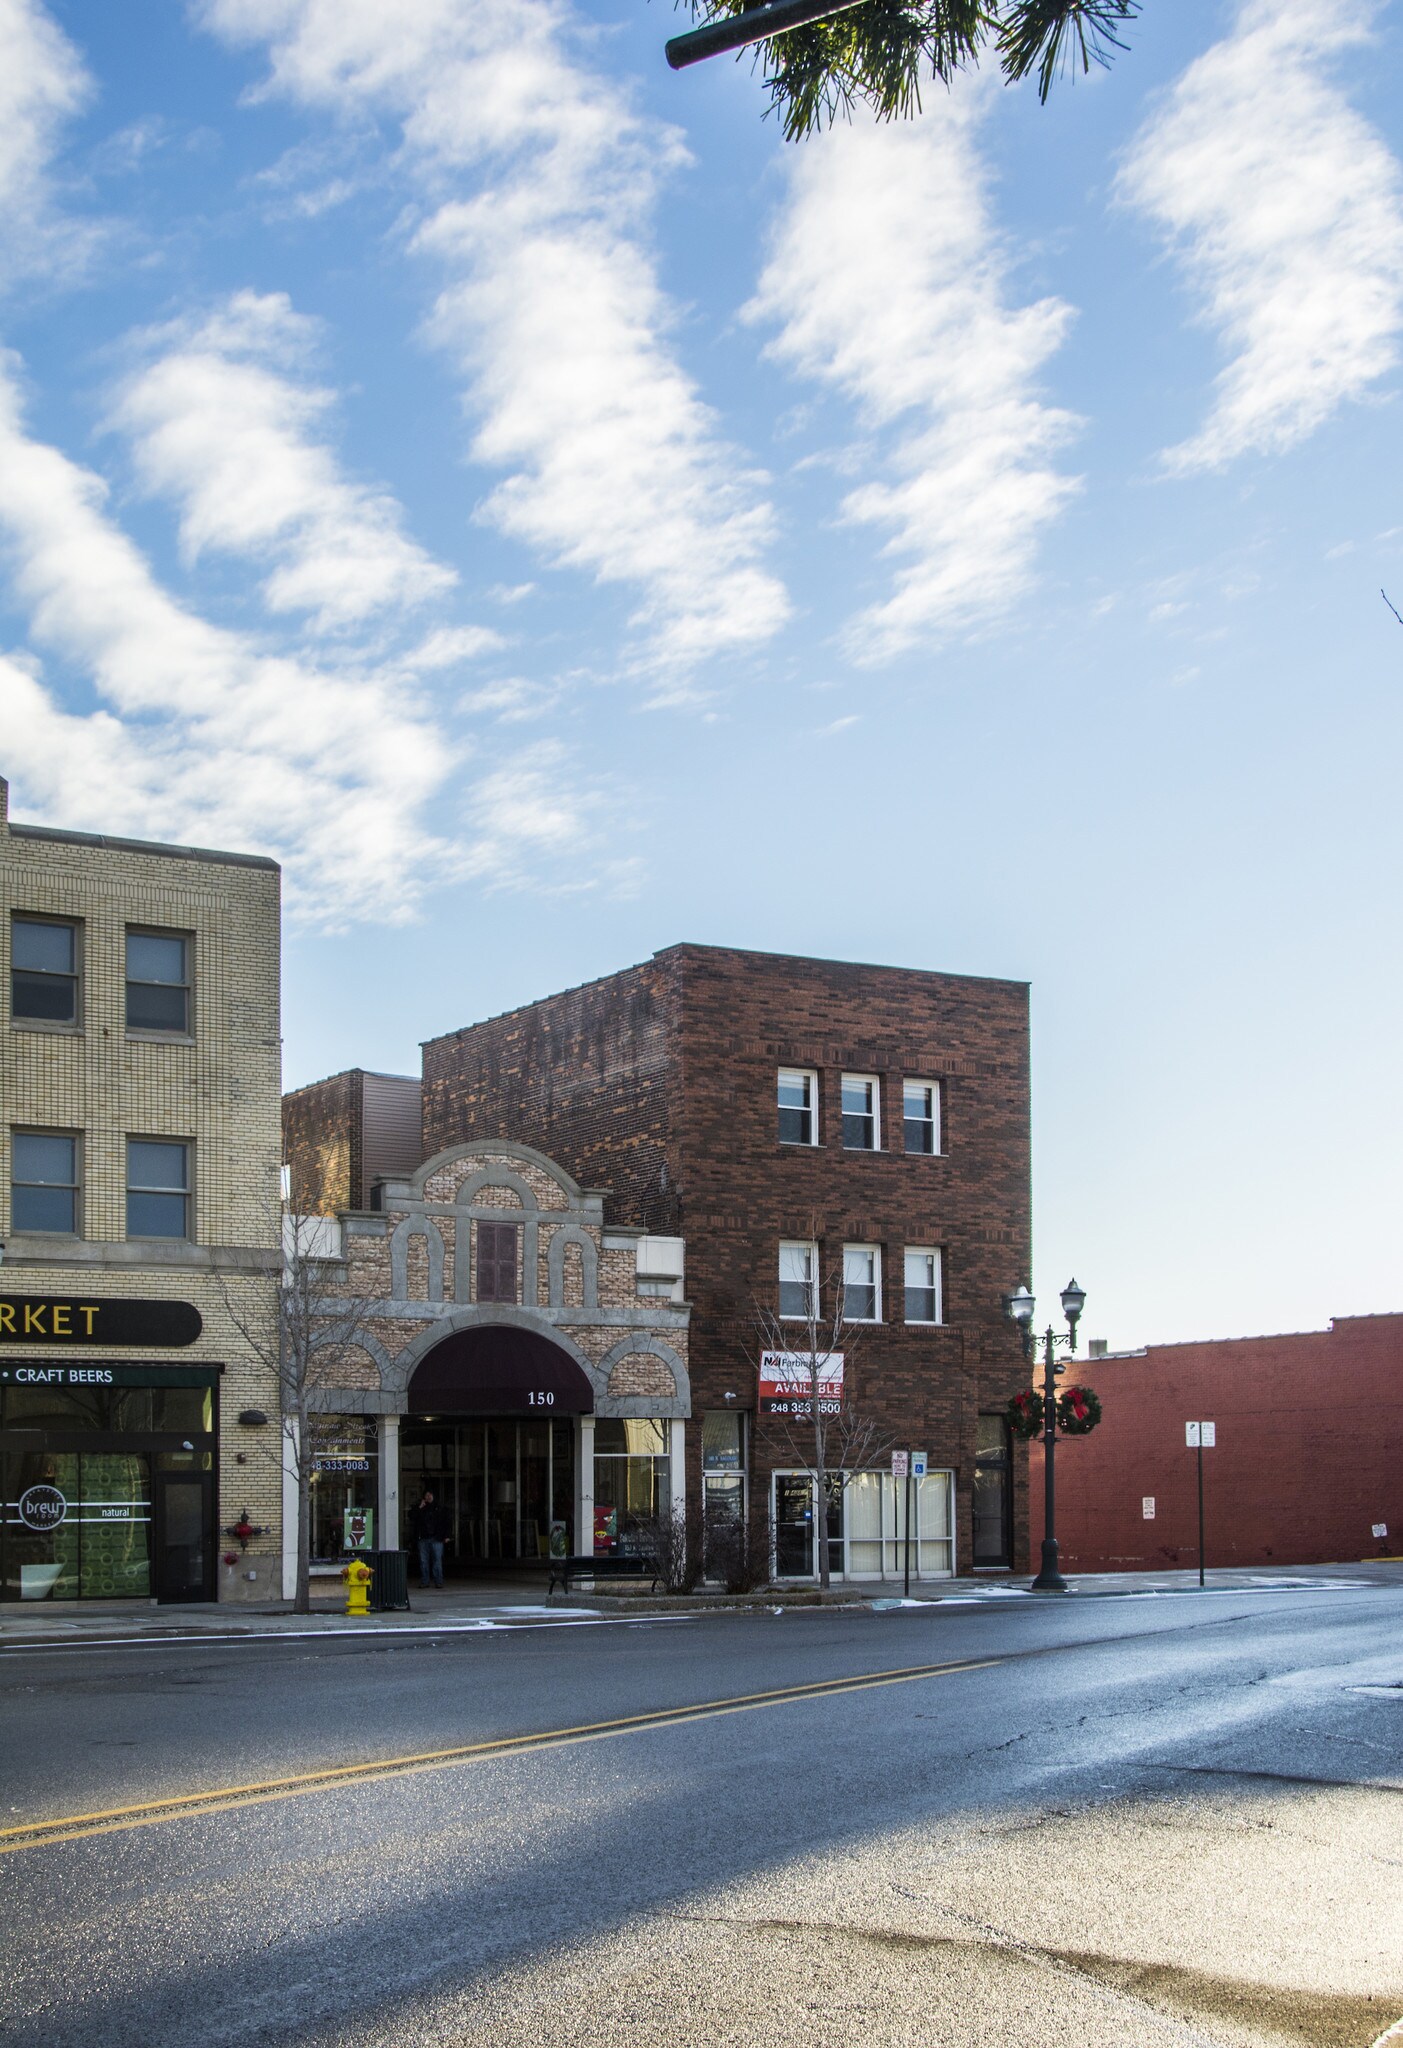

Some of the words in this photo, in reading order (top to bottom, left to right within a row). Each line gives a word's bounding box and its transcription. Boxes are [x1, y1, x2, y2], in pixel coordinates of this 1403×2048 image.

[0, 1303, 100, 1335] RKET
[782, 1358, 819, 1367] Farbn
[15, 1369, 65, 1382] CRAFT
[69, 1369, 113, 1383] BEERS
[775, 1382, 841, 1394] AVAILBLE
[527, 1391, 555, 1405] 150
[770, 1403, 789, 1413] 248
[816, 1403, 841, 1414] 500
[311, 1460, 370, 1471] 48-333-0083
[26, 1500, 60, 1514] brew
[101, 1507, 130, 1517] natural
